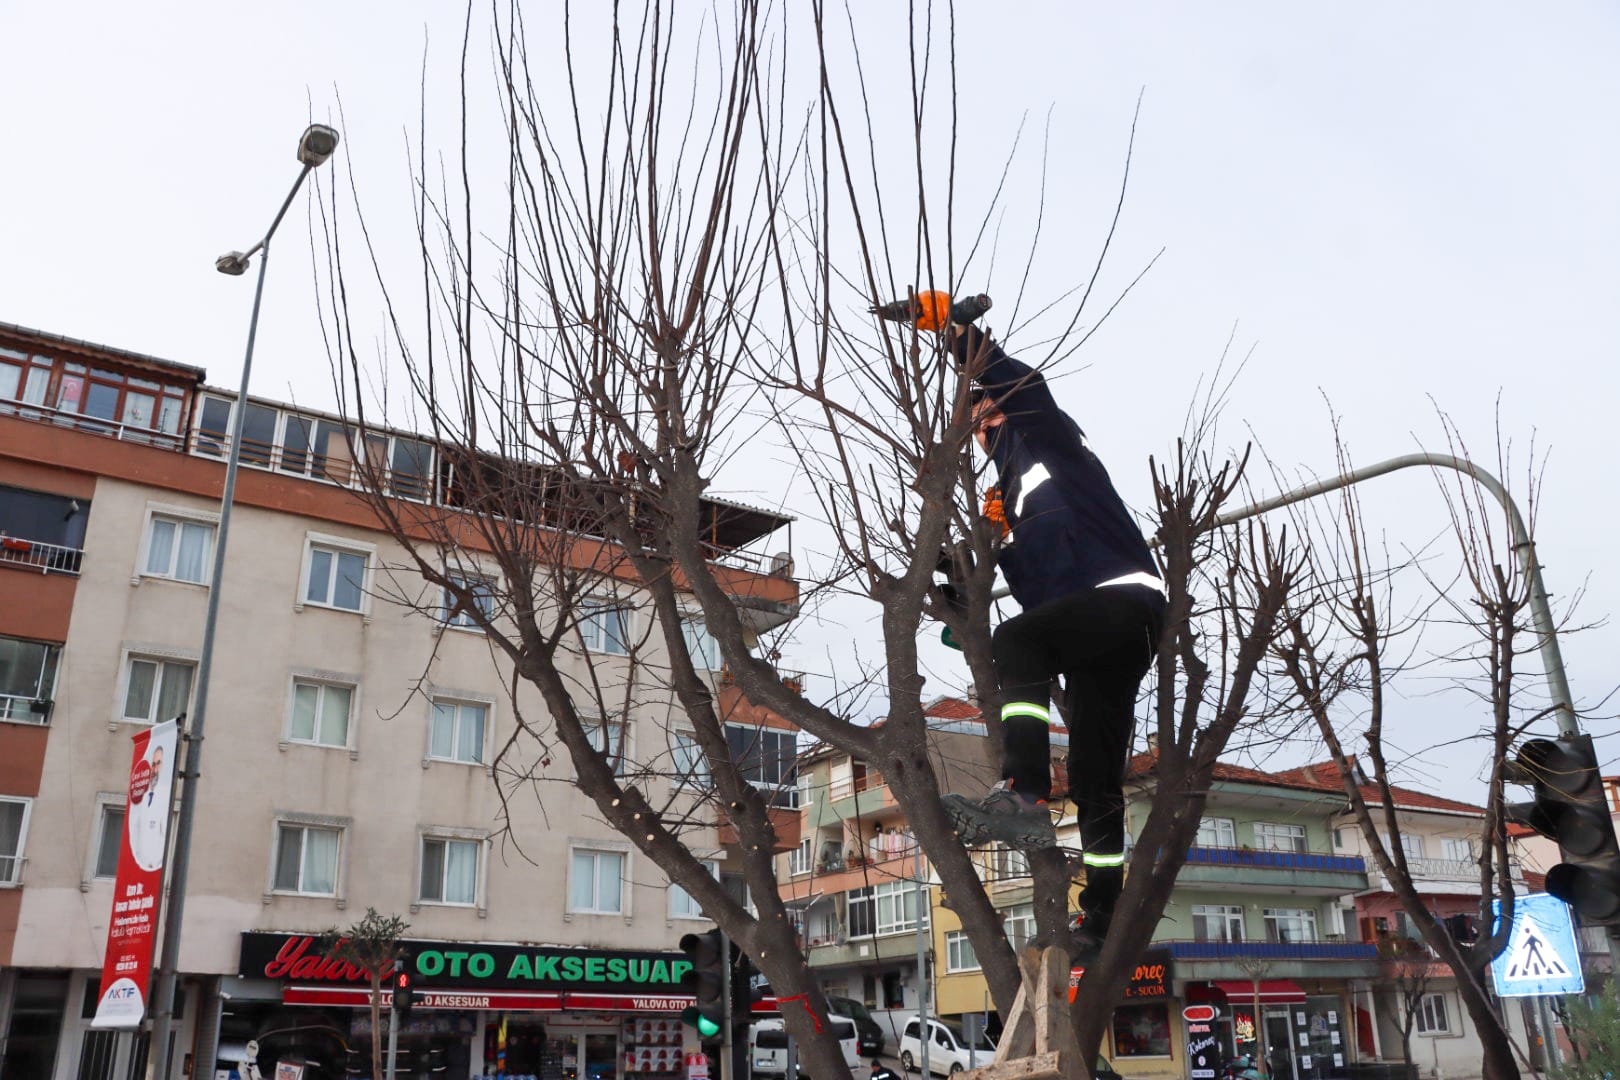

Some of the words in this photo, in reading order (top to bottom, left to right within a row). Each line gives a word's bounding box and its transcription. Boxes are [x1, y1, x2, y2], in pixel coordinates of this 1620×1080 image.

[416, 950, 495, 978] OTO
[434, 996, 490, 1007] AKSESUAR
[632, 999, 668, 1009] YALOVA
[669, 1000, 687, 1010] OTO
